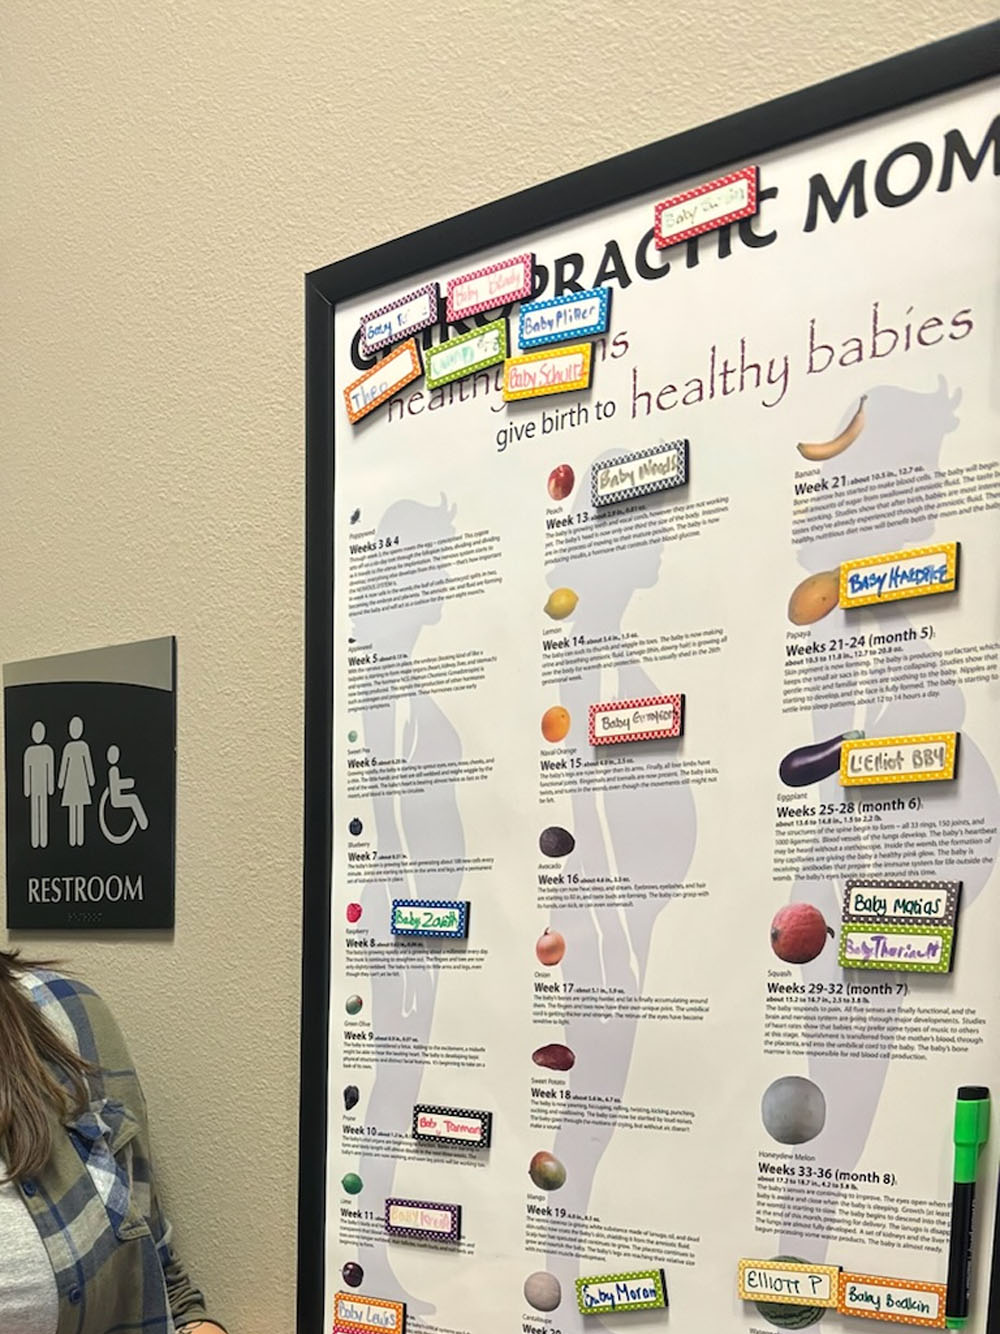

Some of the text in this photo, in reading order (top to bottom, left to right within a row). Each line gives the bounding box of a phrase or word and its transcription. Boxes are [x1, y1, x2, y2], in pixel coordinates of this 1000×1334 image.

[525, 316, 554, 335] Baby
[496, 418, 537, 452] give
[542, 404, 589, 434] birth
[595, 400, 617, 420] to
[631, 337, 788, 418] healthy
[806, 302, 974, 375] babies
[509, 366, 536, 389] Baby
[599, 468, 635, 490] Baby
[794, 468, 820, 479] Banana
[794, 479, 829, 496] Week
[546, 512, 589, 530] Week 13
[350, 536, 399, 554] Weeks 3 & 4
[786, 629, 812, 640] Papaya
[543, 636, 585, 651] Week 14
[786, 641, 826, 657] Weeks
[829, 635, 865, 651] 21-24
[869, 627, 917, 647] (month
[348, 653, 378, 666] Week 5
[602, 717, 630, 730] Baby
[348, 758, 377, 768] Week 6
[540, 758, 582, 771] Week 15
[777, 792, 807, 801] Eggplant
[777, 805, 816, 818] Weeks
[819, 802, 855, 815] 25-28
[858, 798, 905, 814] (month
[348, 851, 377, 861] Week 7
[538, 874, 579, 885] Week 16
[28, 874, 143, 903] RESTROOM
[855, 894, 887, 916] Baby
[346, 938, 376, 948] Week 8
[768, 970, 792, 978] Squash
[534, 983, 574, 993] Week 17
[767, 982, 806, 994] Weeks
[808, 983, 843, 995] 29-32
[846, 983, 893, 995] (month
[344, 1031, 374, 1040] Week 9
[531, 1088, 571, 1100] Week 18
[343, 1125, 377, 1136] Week 10
[795, 1154, 816, 1162] Melon
[758, 1163, 796, 1177] Weeks
[799, 1166, 833, 1179] 33-36
[835, 1168, 880, 1184] (month
[340, 1208, 374, 1220] Week 11
[526, 1204, 566, 1218] Week 19
[808, 1275, 823, 1296] P
[849, 1286, 881, 1310] Baby
